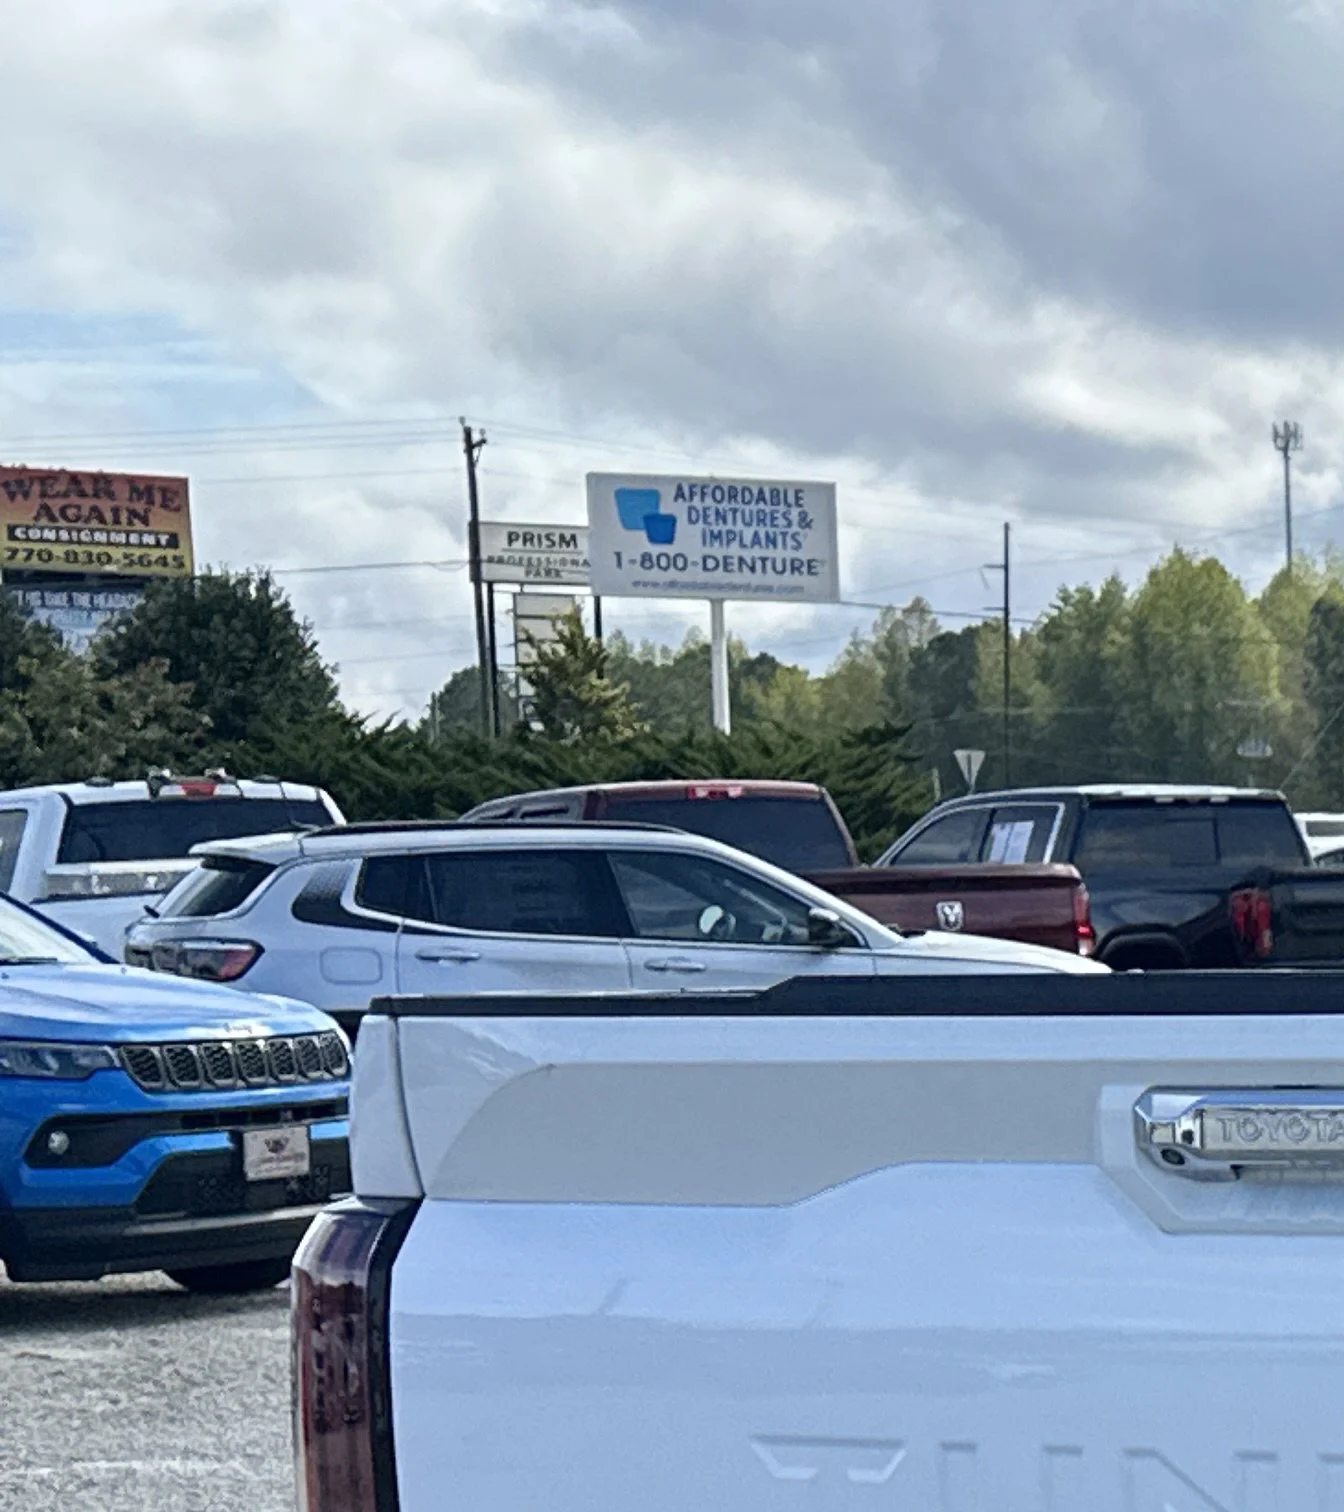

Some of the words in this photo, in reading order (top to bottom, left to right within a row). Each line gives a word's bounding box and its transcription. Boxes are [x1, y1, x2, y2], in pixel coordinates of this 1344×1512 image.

[2, 475, 115, 501] WEAR
[129, 482, 181, 512] ME
[673, 482, 805, 509] AFFORDABLE
[34, 502, 149, 526] AGAIN
[687, 505, 793, 530] DENTURES
[797, 510, 814, 531] &
[14, 527, 170, 546] CONSIGNMENT
[506, 530, 579, 550] PRISM
[701, 529, 804, 551] IMPLANTS
[486, 554, 592, 568] PROFESSIONA
[612, 551, 820, 578] 1-800-DENTURE
